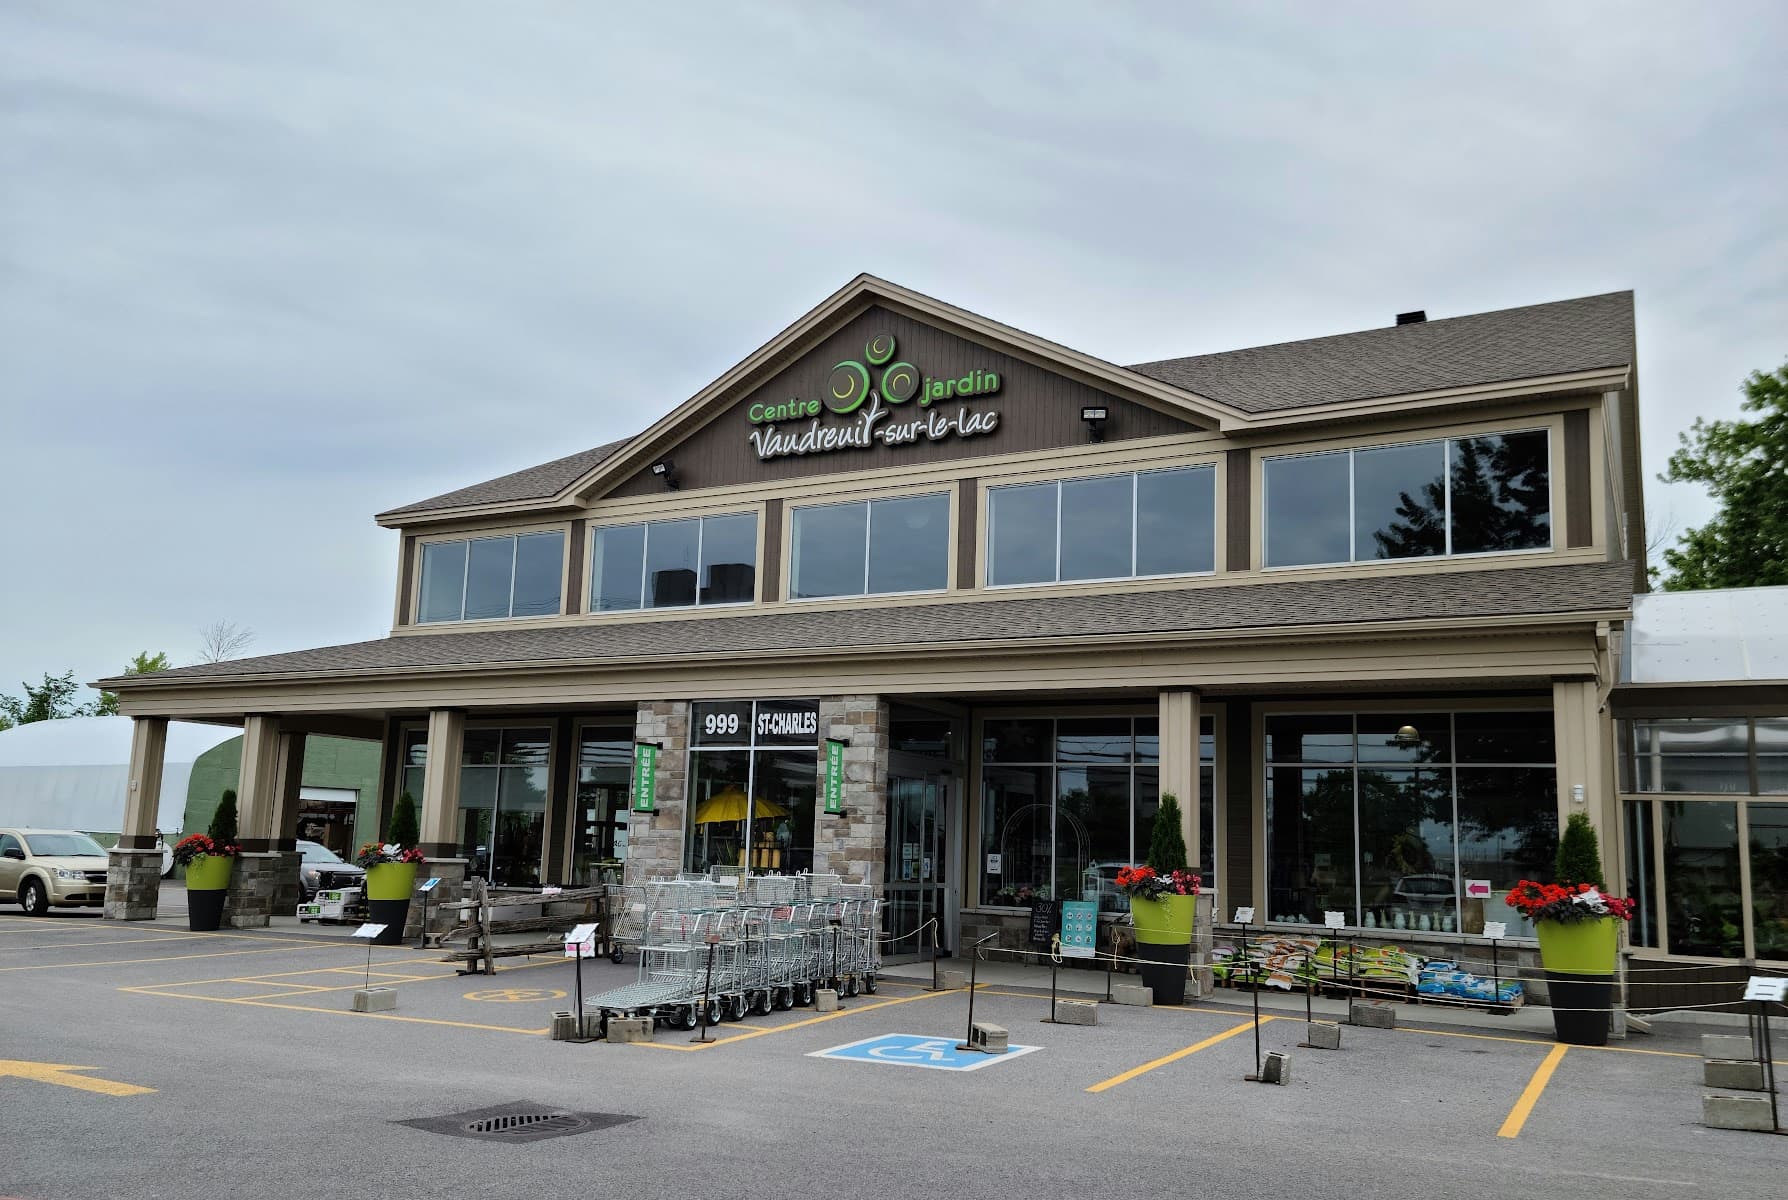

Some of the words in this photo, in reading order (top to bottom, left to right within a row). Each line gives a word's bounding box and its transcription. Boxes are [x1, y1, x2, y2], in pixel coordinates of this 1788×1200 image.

[749, 400, 820, 422] Centre
[920, 370, 998, 404] jardin
[749, 393, 997, 457] Vaudreuil-sur-le-lac
[705, 713, 739, 735] 999
[757, 711, 817, 735] ST-CHARLES
[640, 747, 651, 808] ENTRÉE
[830, 745, 840, 809] ENTRÉE
[1035, 902, 1053, 914] 30%
